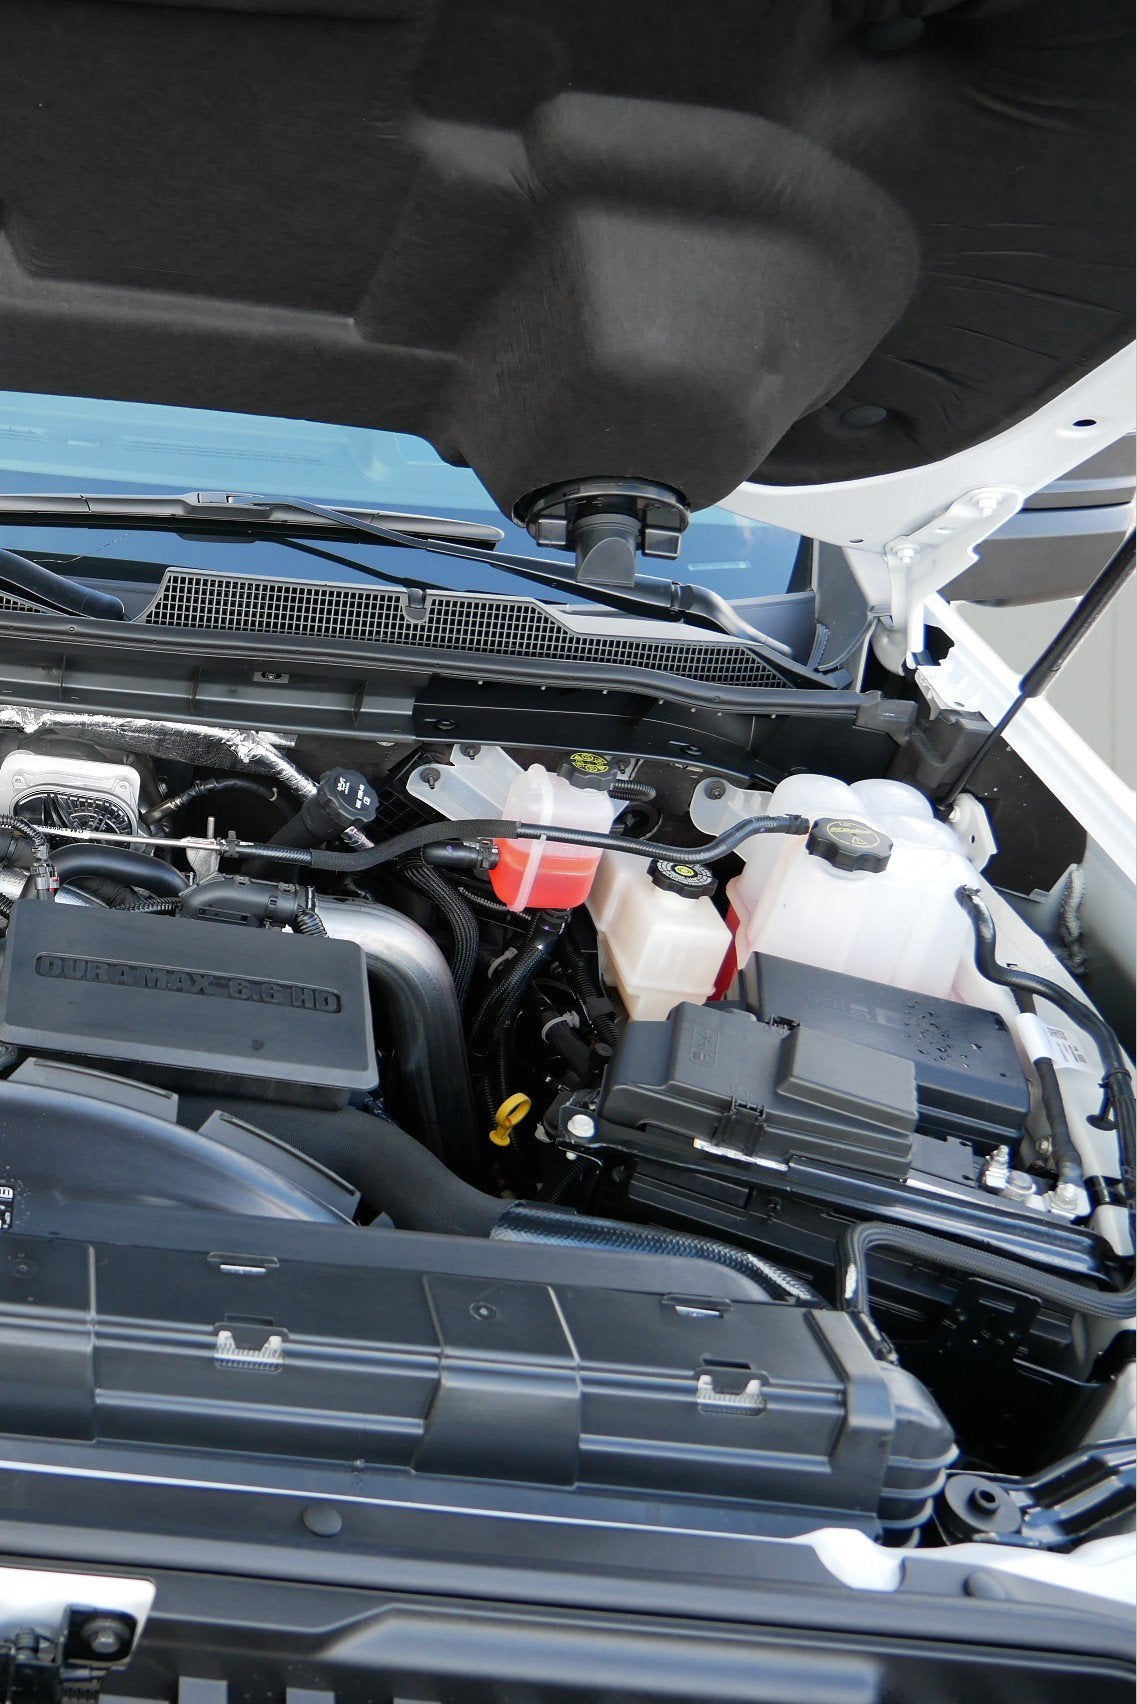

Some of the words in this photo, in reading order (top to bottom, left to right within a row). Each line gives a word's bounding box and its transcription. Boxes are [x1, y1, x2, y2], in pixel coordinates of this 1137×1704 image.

[41, 956, 214, 994] DURAMAX
[229, 978, 284, 1002] 6.6
[291, 986, 338, 1012] HD
